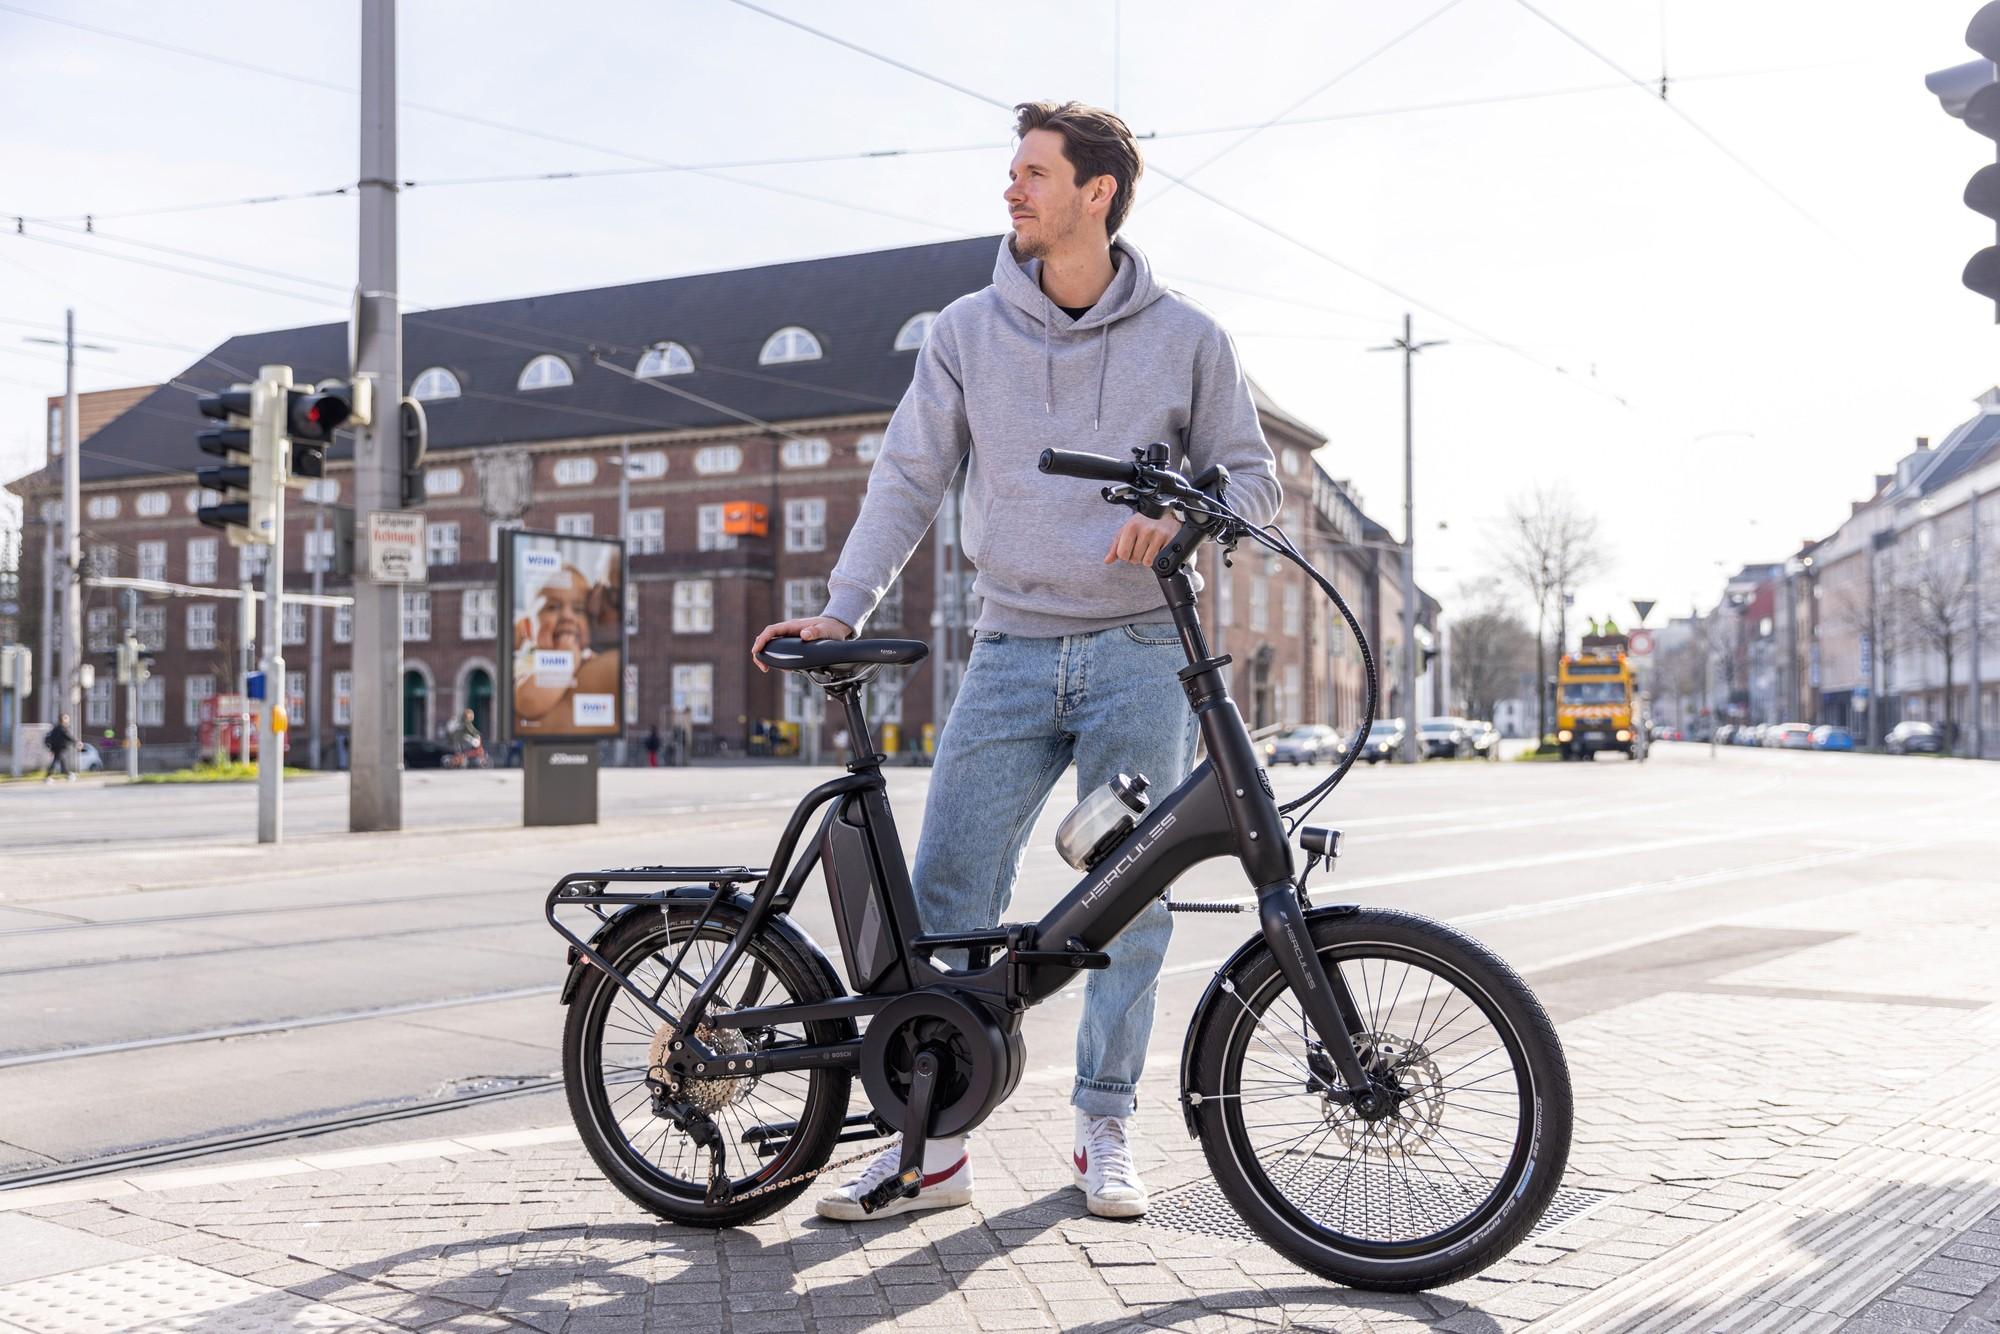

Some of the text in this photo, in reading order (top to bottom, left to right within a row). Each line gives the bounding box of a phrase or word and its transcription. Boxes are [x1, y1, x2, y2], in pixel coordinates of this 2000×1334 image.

[1081, 812, 1177, 910] HERCULES
[1284, 922, 1317, 990] HERCULES
[1532, 1095, 1543, 1159] SCHWALBE
[1471, 1199, 1516, 1244] BIG APPLE
